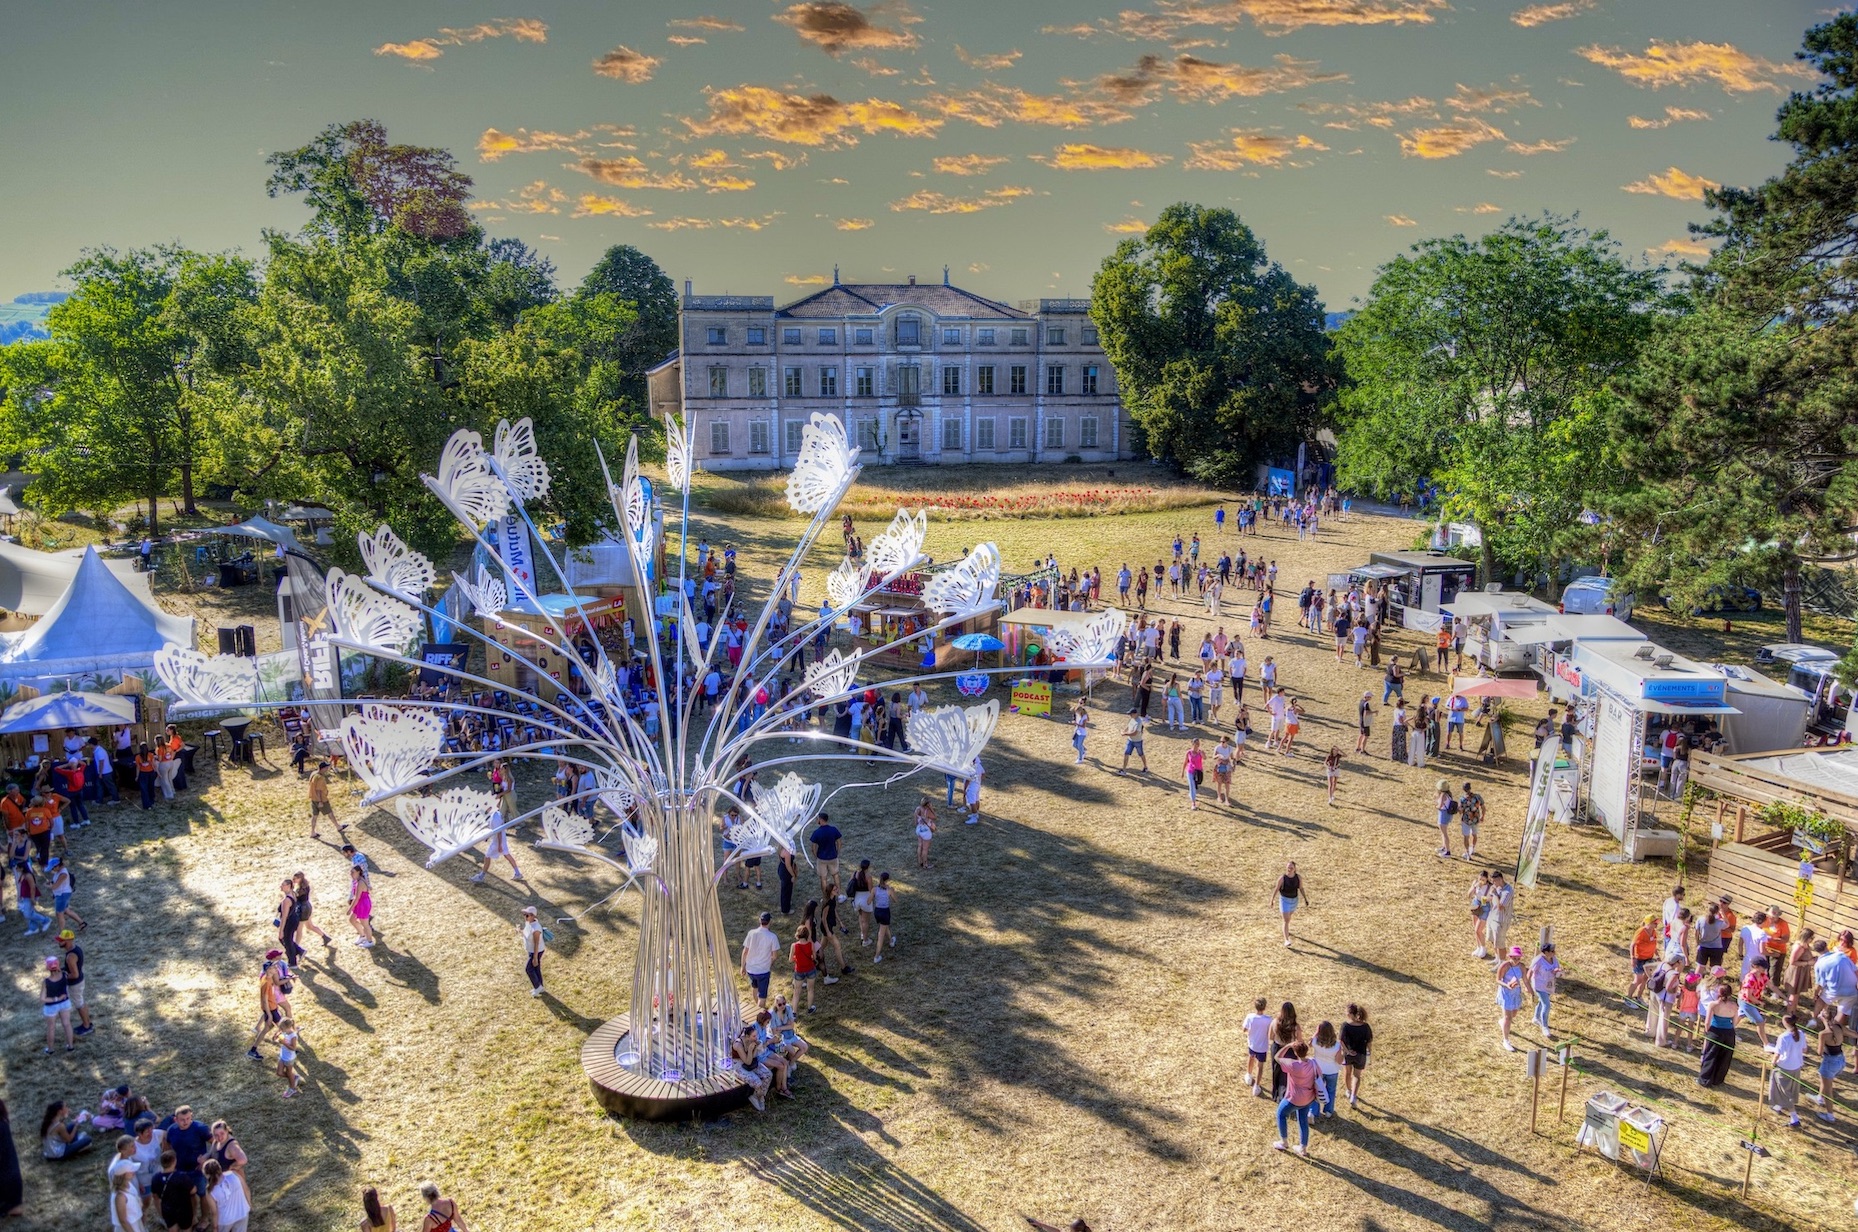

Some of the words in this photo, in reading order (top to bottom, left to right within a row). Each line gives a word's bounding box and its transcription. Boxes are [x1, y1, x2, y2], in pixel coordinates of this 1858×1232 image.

[425, 653, 453, 665] RIFF
[1648, 684, 1695, 692] ÉVÉNEMENTS
[1013, 692, 1050, 701] PODCAST
[1608, 703, 1622, 721] BAR
[1744, 1142, 1760, 1154] WC
